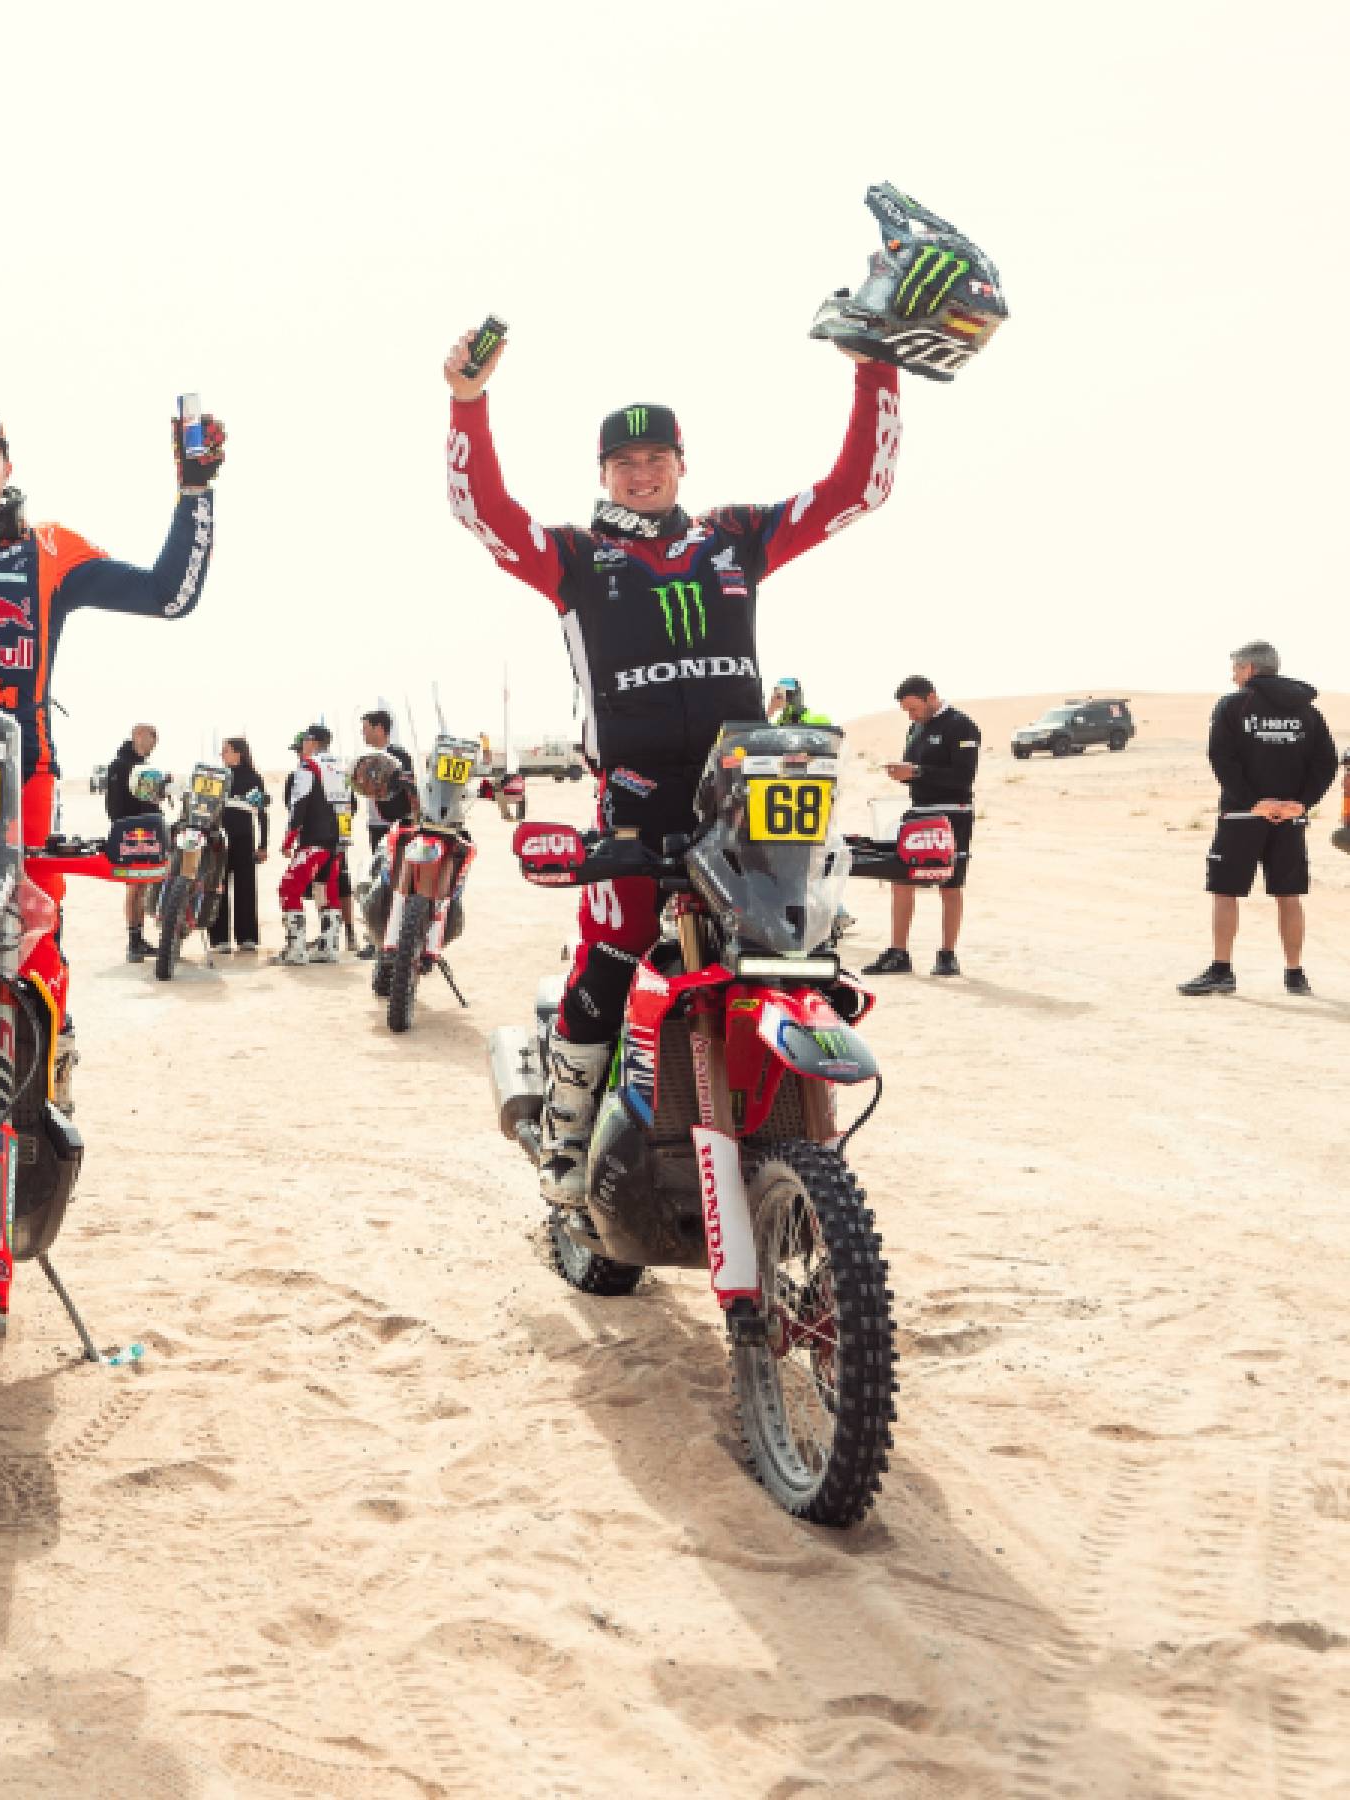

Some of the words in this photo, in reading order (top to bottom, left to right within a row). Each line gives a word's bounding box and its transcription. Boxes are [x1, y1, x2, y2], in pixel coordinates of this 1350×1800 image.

[616, 656, 757, 691] HONDA
[764, 785, 822, 835] 68
[521, 833, 576, 855] GIVI
[903, 827, 952, 849] GIVI
[697, 1142, 725, 1275] HONDA
